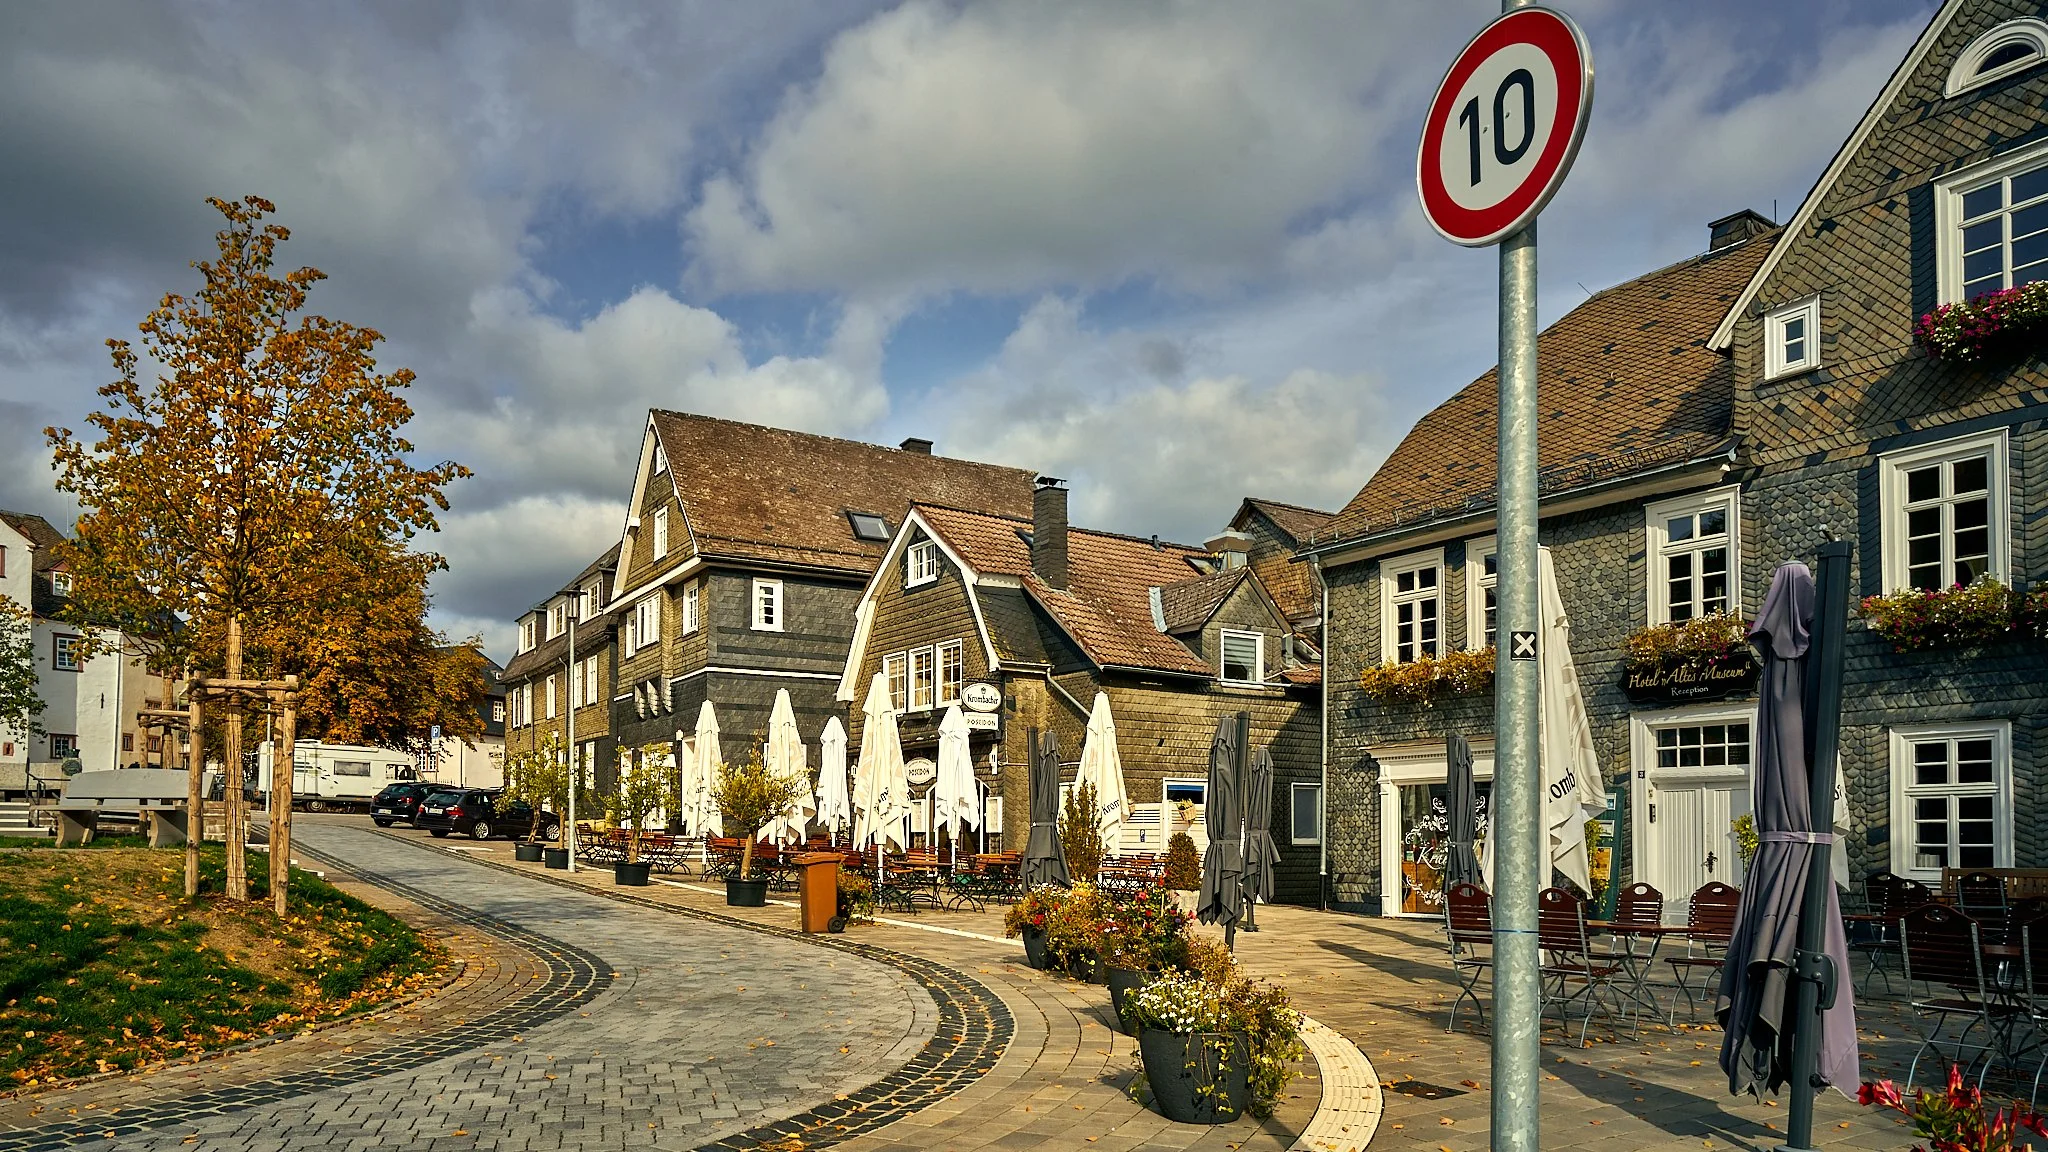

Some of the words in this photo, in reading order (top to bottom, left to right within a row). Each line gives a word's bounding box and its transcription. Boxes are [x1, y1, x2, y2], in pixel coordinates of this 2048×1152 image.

[1459, 68, 1535, 187] 10
[1629, 668, 1659, 688] Hotel
[1671, 685, 1709, 697] Reception
